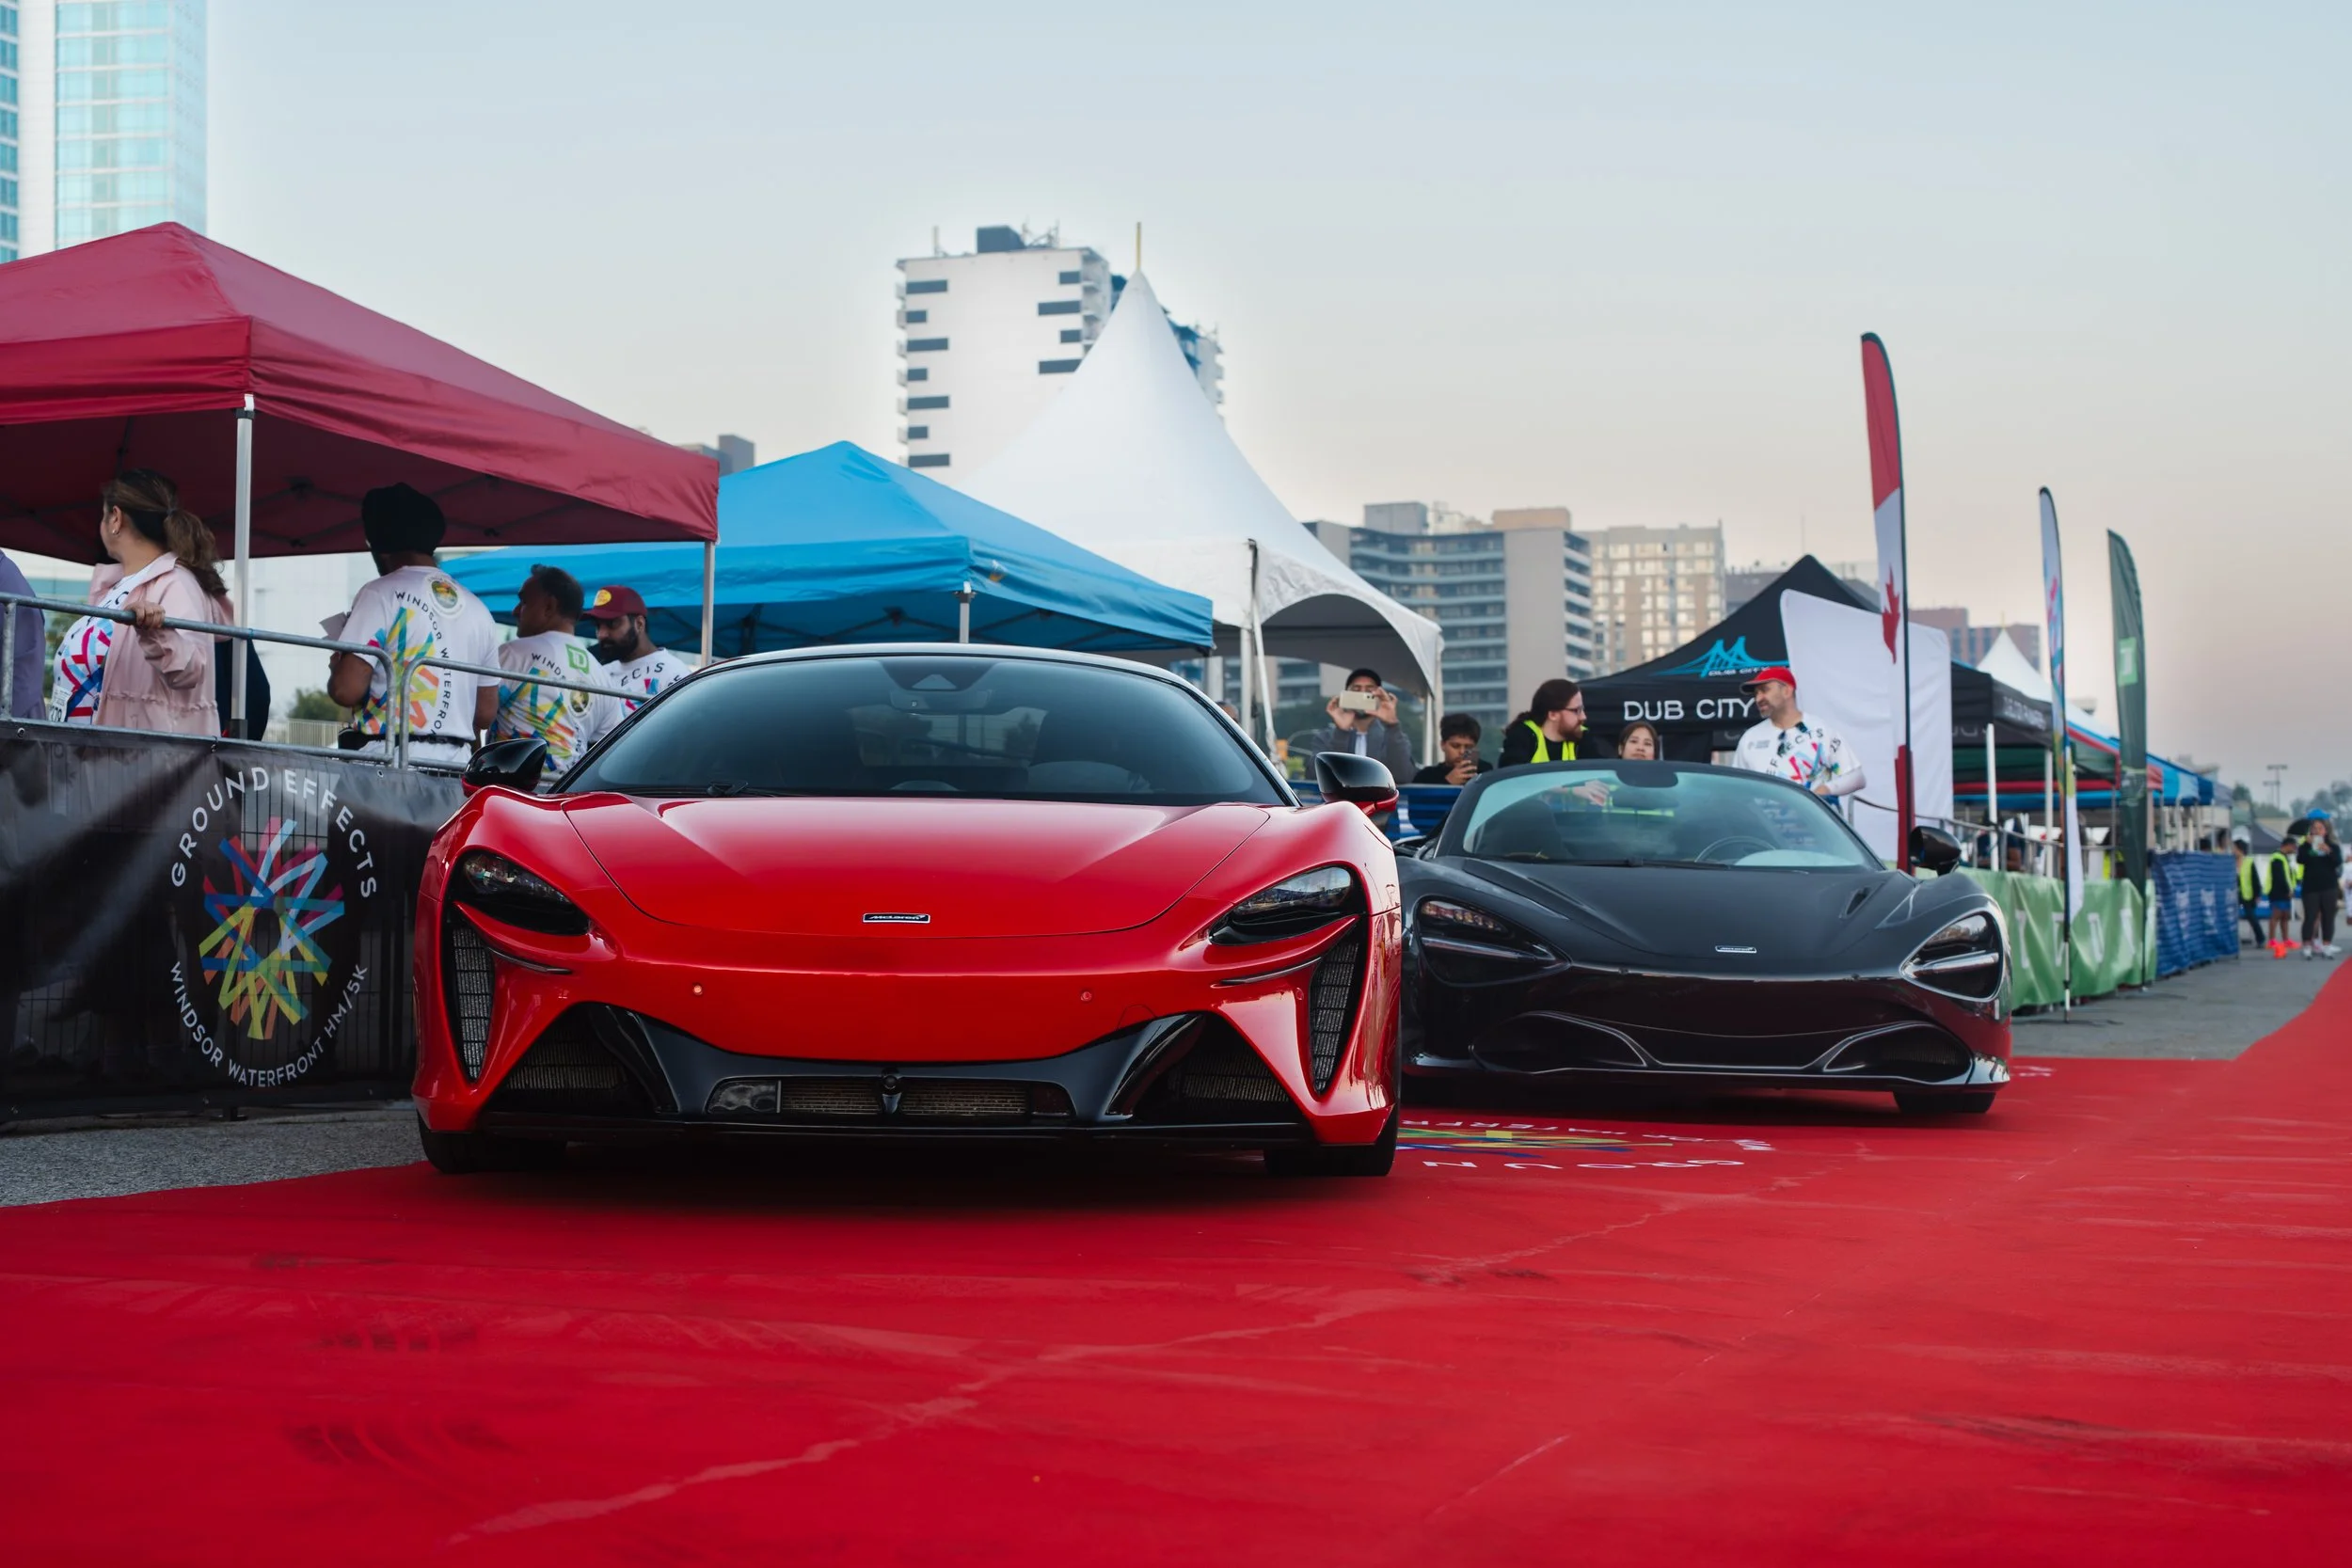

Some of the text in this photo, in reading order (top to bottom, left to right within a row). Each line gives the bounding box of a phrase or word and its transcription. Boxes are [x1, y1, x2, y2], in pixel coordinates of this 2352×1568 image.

[430, 647, 452, 735] WTERFRO
[531, 653, 566, 679] WIND
[1624, 698, 1756, 721] DUB CITY
[171, 767, 377, 897] GROUND EFFECTS
[170, 961, 369, 1088] WINDSOR WATERFRONT HM/5K
